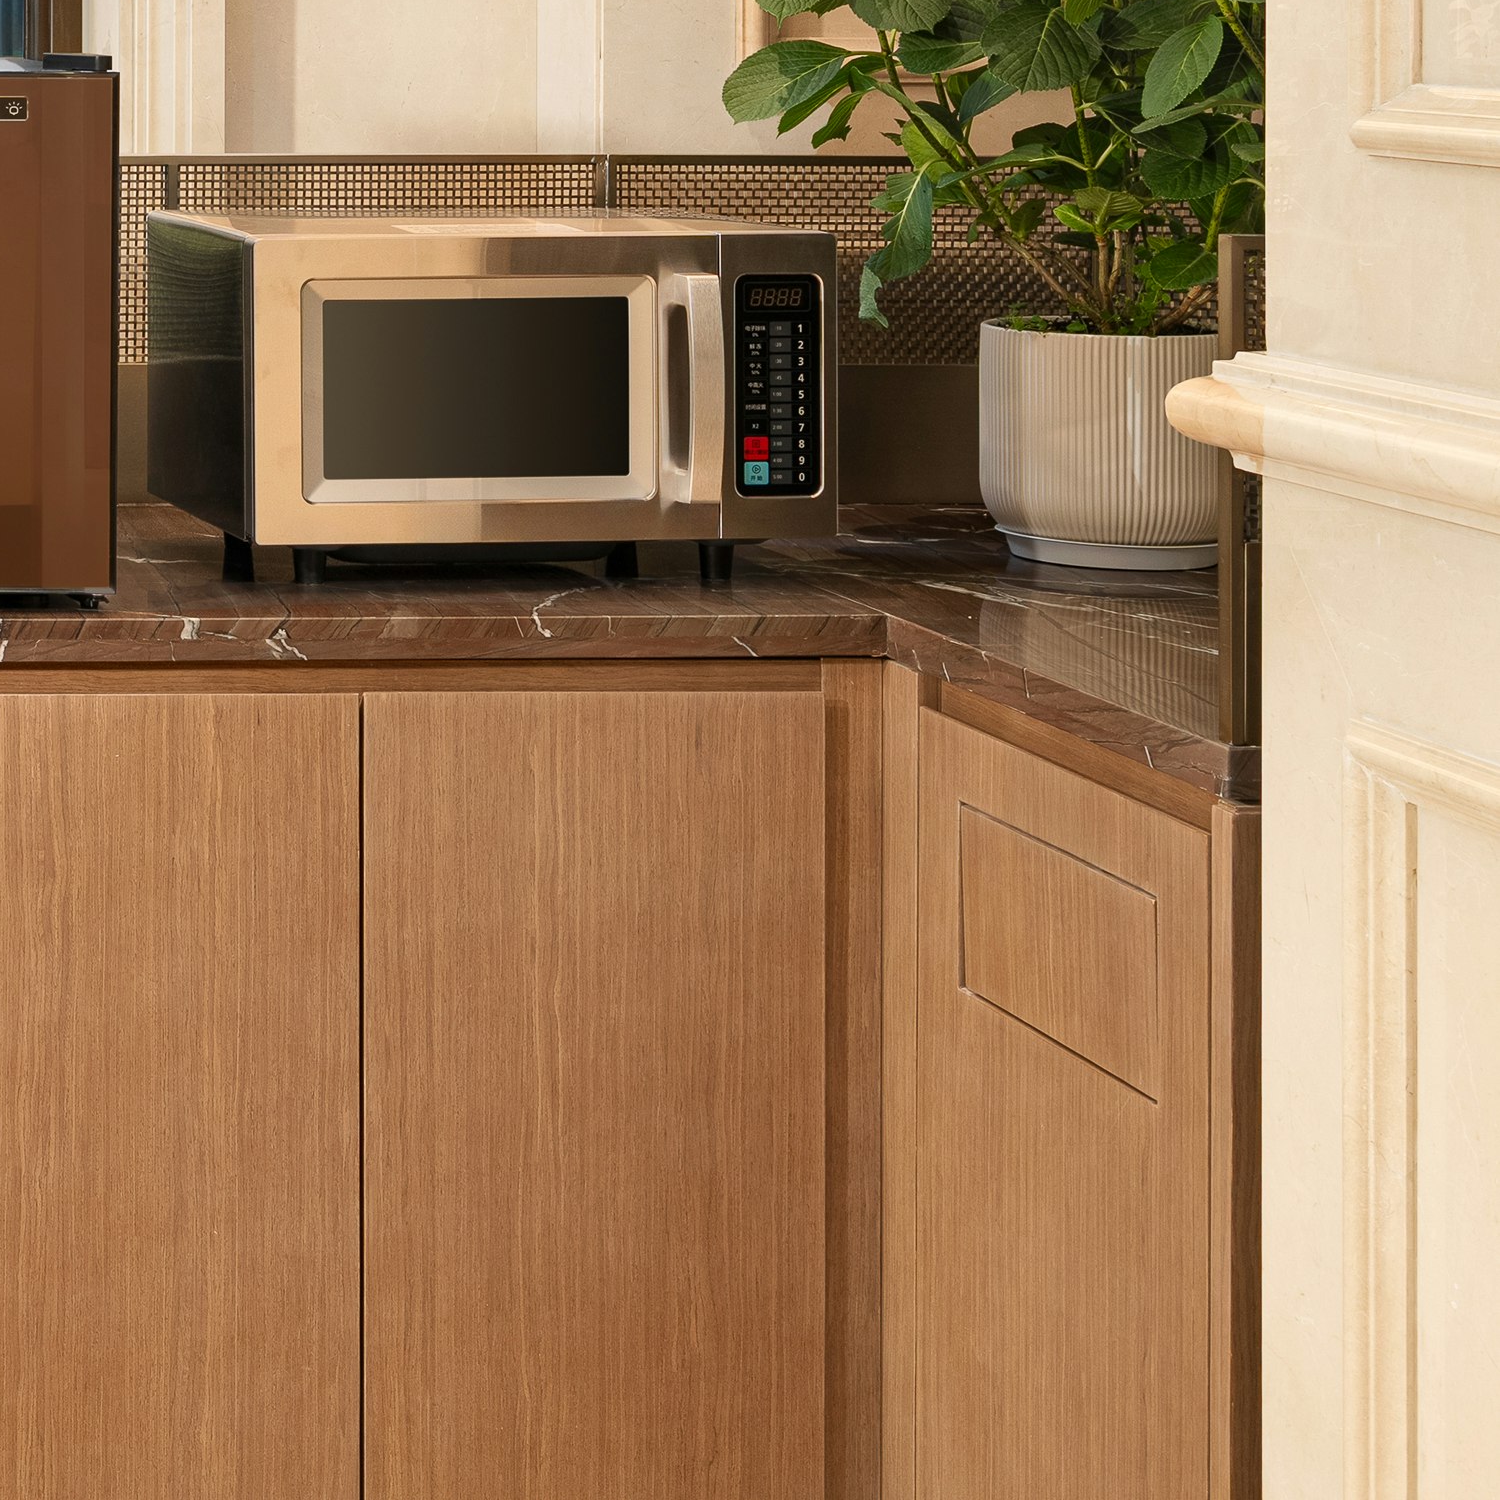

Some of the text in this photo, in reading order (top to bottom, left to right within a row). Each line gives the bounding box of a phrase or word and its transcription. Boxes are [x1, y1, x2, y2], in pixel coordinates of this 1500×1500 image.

[797, 323, 803, 333] 1
[797, 340, 804, 350] 2
[797, 356, 804, 366] 3
[797, 373, 805, 383] 4
[798, 390, 805, 399] 5
[798, 406, 805, 416] 6
[798, 423, 805, 432] 7
[798, 439, 805, 449] 8
[798, 456, 805, 465] 9
[798, 472, 805, 482] 0
